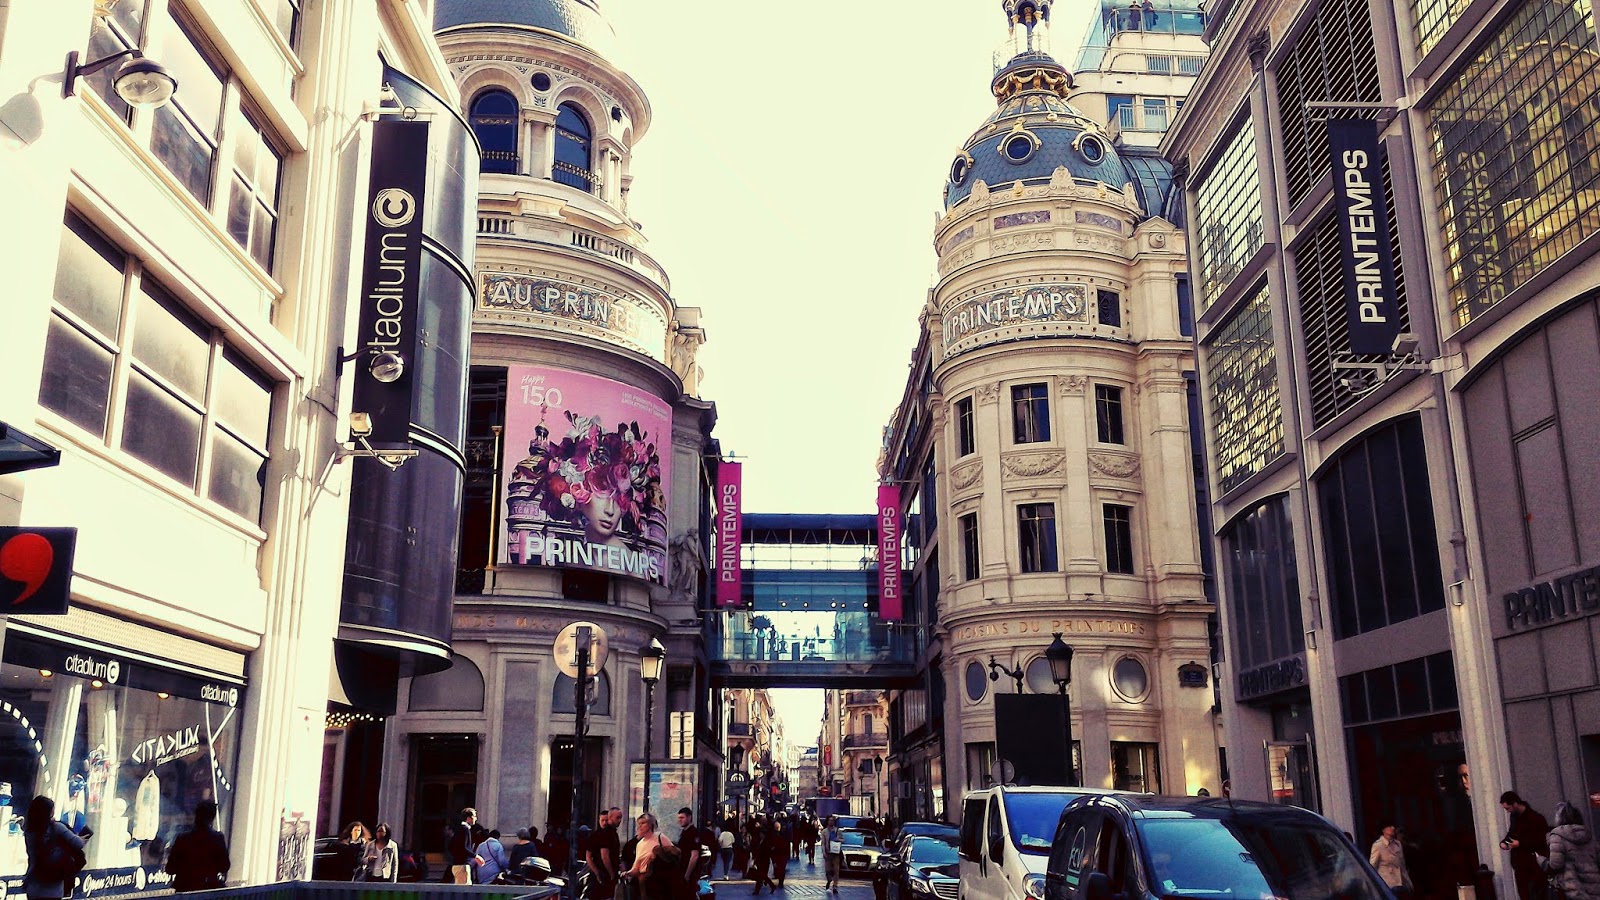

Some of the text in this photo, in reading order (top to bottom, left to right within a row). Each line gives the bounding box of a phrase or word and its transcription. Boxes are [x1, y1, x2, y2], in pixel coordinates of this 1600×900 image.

[1343, 149, 1387, 323] PRINTEMPS
[367, 233, 408, 355] itadium
[490, 281, 651, 338] AU PRINTE
[952, 292, 1078, 338] PRINTEMPS
[520, 385, 563, 408] 150
[722, 484, 737, 582] PRINTEMPS
[882, 506, 897, 599] PRINTEMPS
[525, 536, 659, 580] PRINTEMPS
[1020, 621, 1040, 633] DU
[1052, 620, 1145, 635] PRINTEMPS
[65, 654, 107, 679] citadium
[114, 873, 132, 887] hours
